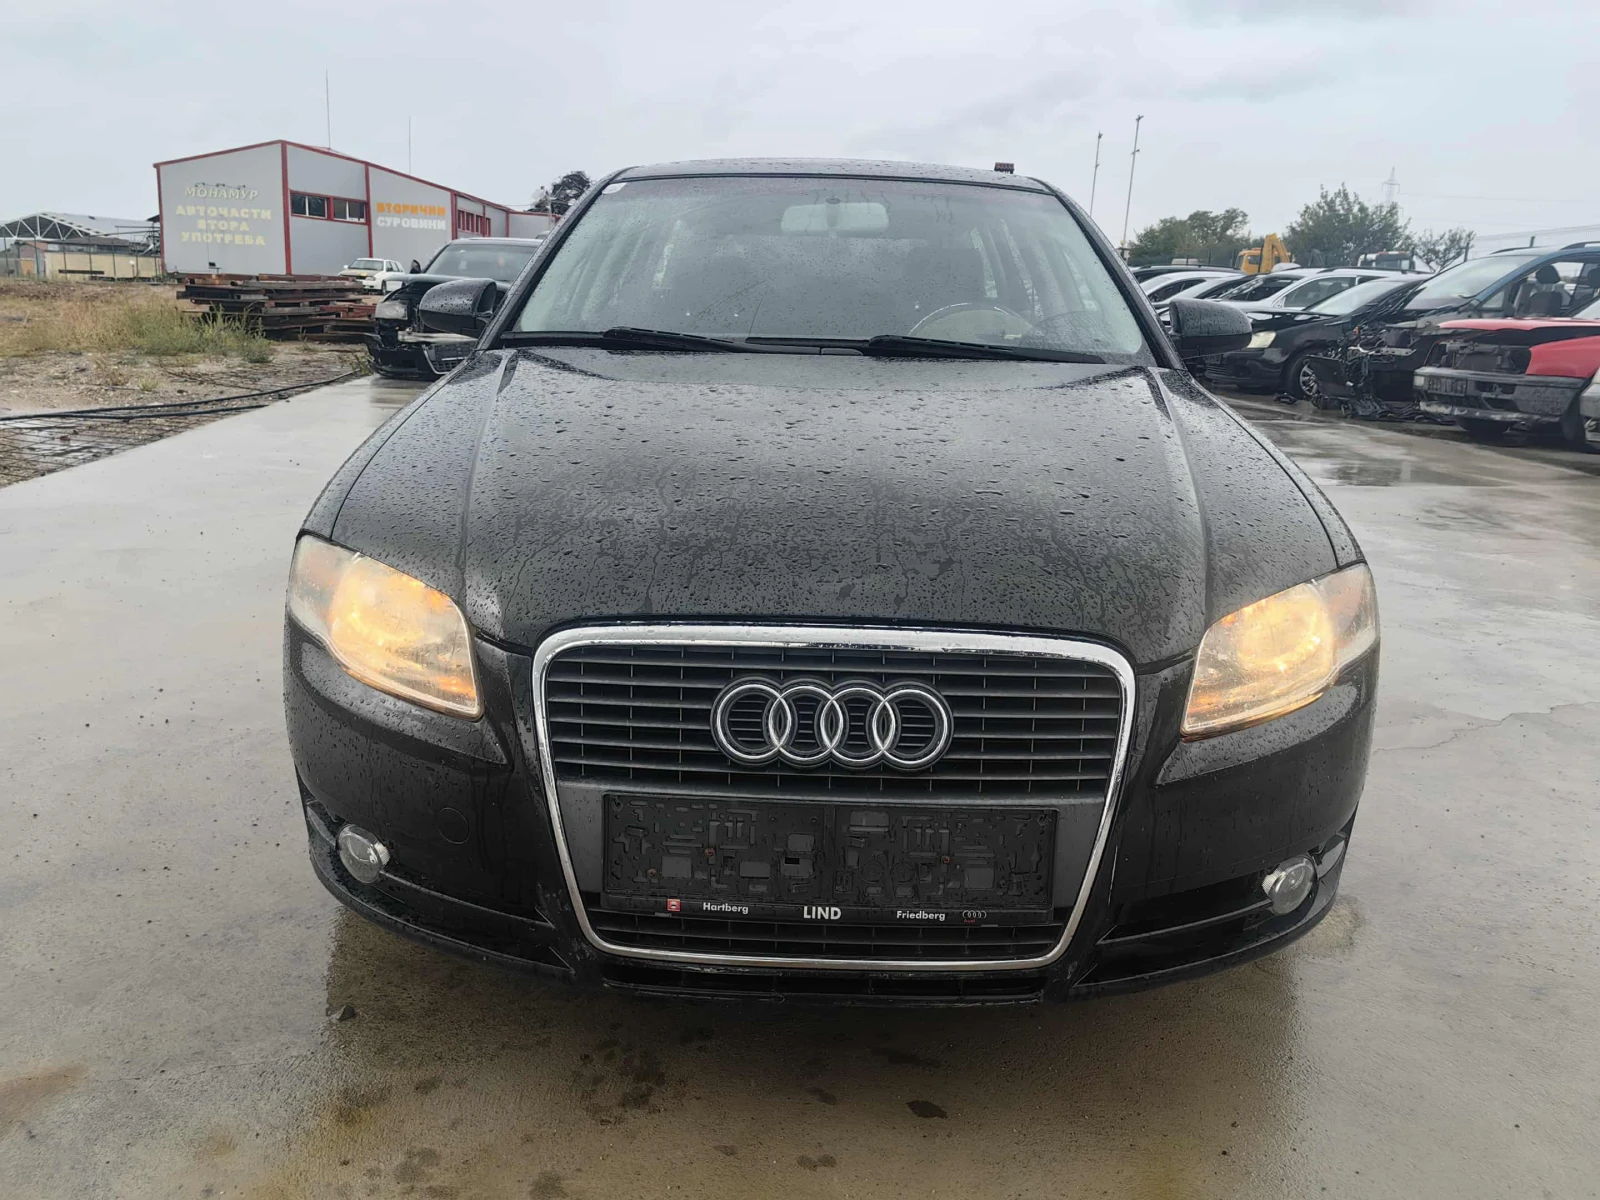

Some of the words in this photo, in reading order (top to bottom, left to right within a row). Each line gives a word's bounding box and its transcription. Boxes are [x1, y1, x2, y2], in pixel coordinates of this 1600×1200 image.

[185, 187, 258, 200] МОНАМУР
[175, 204, 272, 219] АВТОЧАСТИ
[376, 202, 446, 217] ВТОРИЧНИ
[197, 219, 249, 232] ВТОРА
[376, 216, 446, 230] СУРОВИНИ
[181, 231, 266, 246] УПОТРЕБА
[702, 902, 749, 915] Hartberg
[803, 905, 842, 920] LIND
[896, 910, 946, 922] Friedberg
